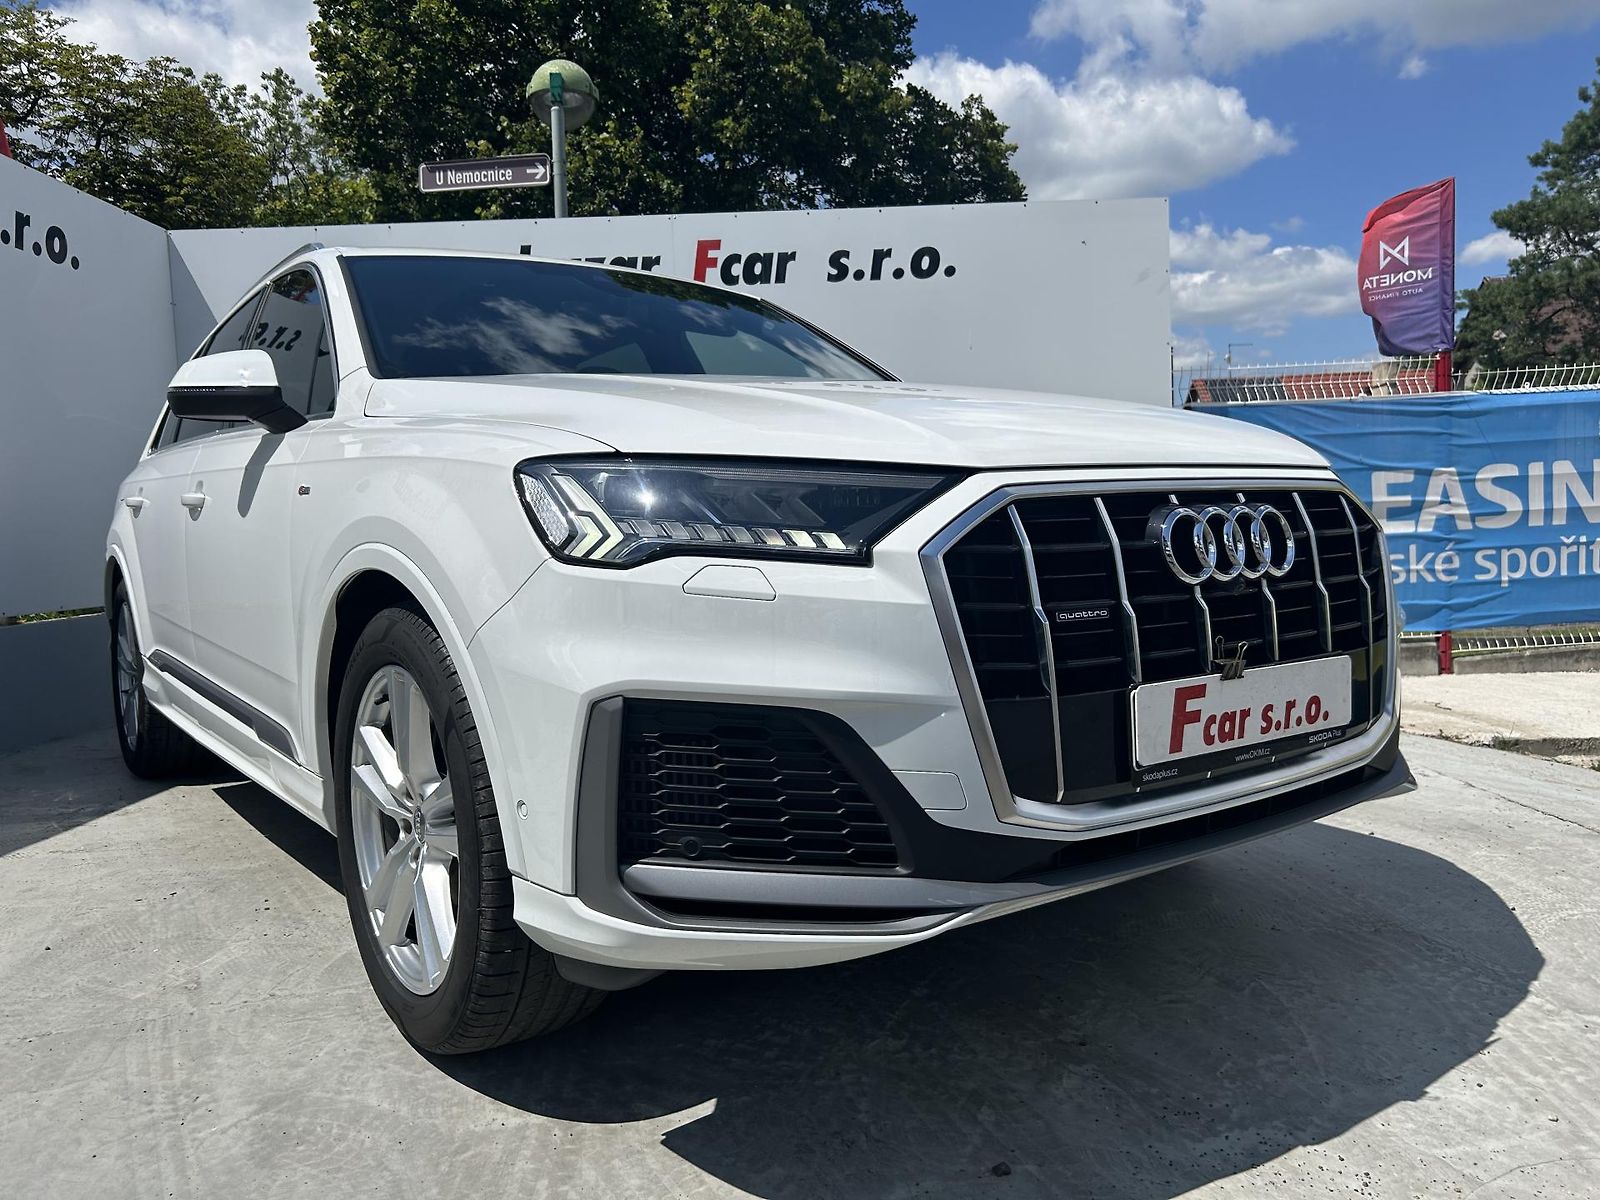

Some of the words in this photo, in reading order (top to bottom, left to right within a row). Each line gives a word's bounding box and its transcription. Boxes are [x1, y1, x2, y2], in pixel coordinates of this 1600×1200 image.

[435, 170, 444, 185] U
[447, 166, 513, 184] Nemocnice
[693, 239, 797, 286] Fcar
[826, 245, 957, 283] s.r.o.
[1059, 610, 1108, 620] quattro
[1168, 683, 1252, 755] Fcar
[1260, 695, 1330, 735] s.r.o.
